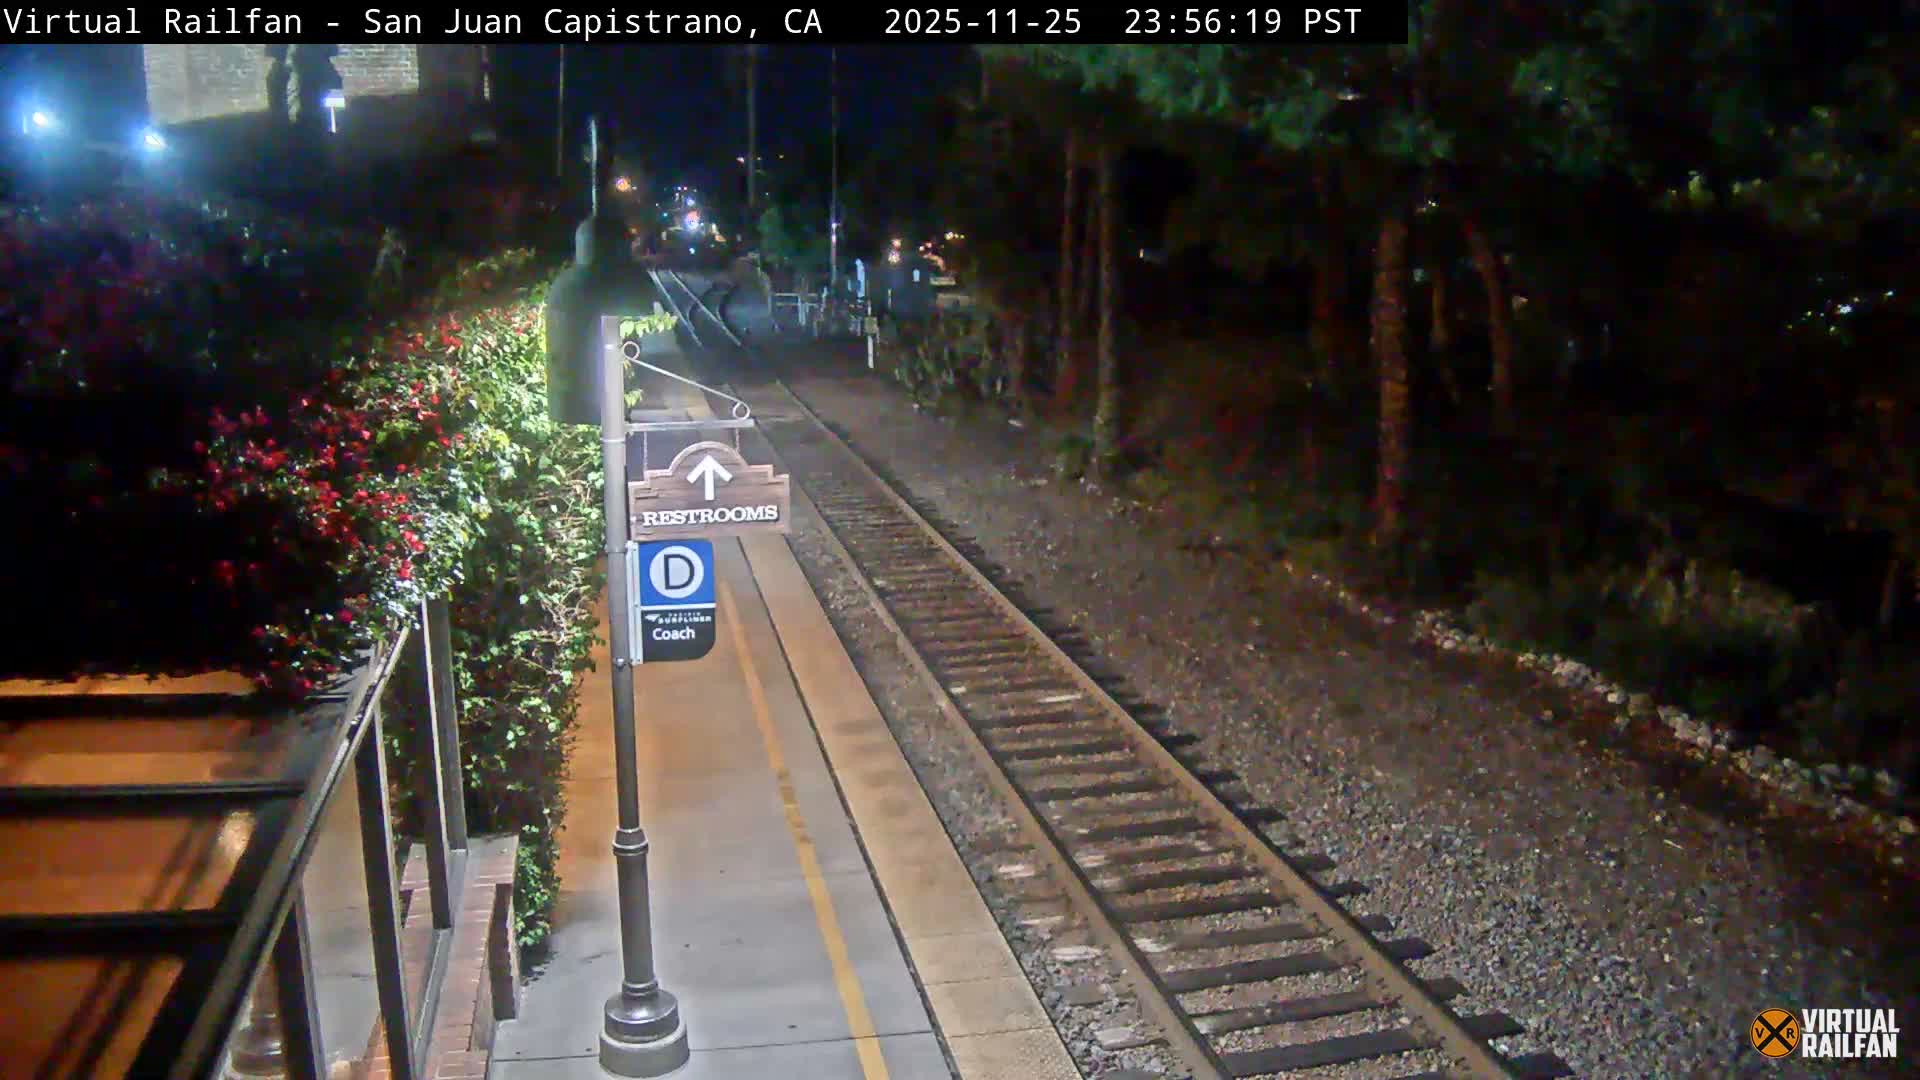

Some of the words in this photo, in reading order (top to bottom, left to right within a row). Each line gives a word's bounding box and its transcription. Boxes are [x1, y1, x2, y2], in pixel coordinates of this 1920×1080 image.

[642, 505, 779, 527] RESTROOMS
[663, 554, 695, 590] D
[652, 626, 696, 640] Coach
